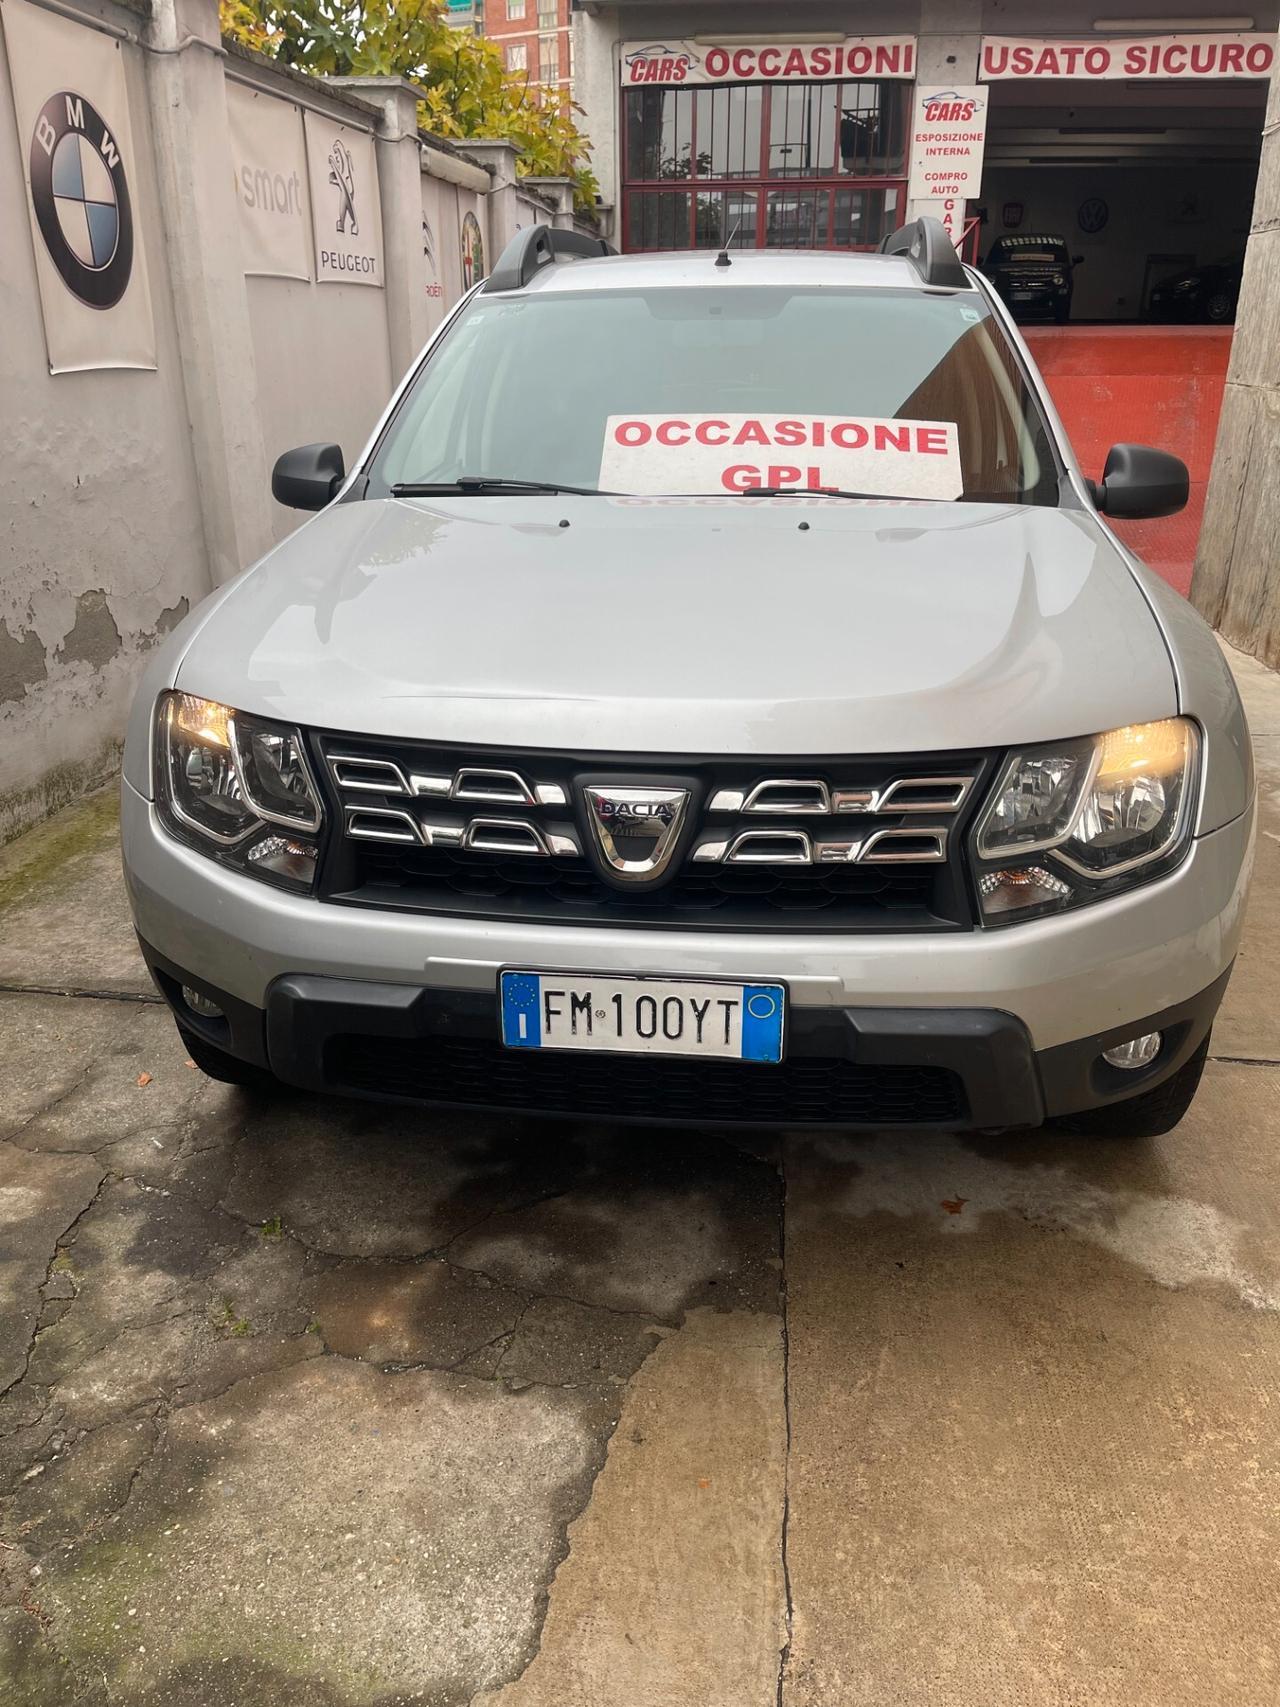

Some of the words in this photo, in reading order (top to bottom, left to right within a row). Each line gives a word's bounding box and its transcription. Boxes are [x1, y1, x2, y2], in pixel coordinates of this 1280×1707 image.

[630, 57, 689, 82] CARS
[705, 44, 913, 77] OCCASIONI
[983, 46, 1111, 75] USATO
[1123, 43, 1273, 75] SICURO
[925, 102, 975, 121] CARS
[35, 95, 120, 169] BMW
[915, 132, 983, 142] ESPOSIZIONE
[926, 147, 970, 156] INTERNA
[924, 172, 968, 181] COMPRO
[241, 164, 303, 216] smart
[931, 186, 959, 194] AUTO
[321, 250, 376, 273] PEUGEOT
[614, 420, 948, 455] OCCASIONE
[721, 464, 839, 493] GPL
[601, 802, 672, 818] DACIA
